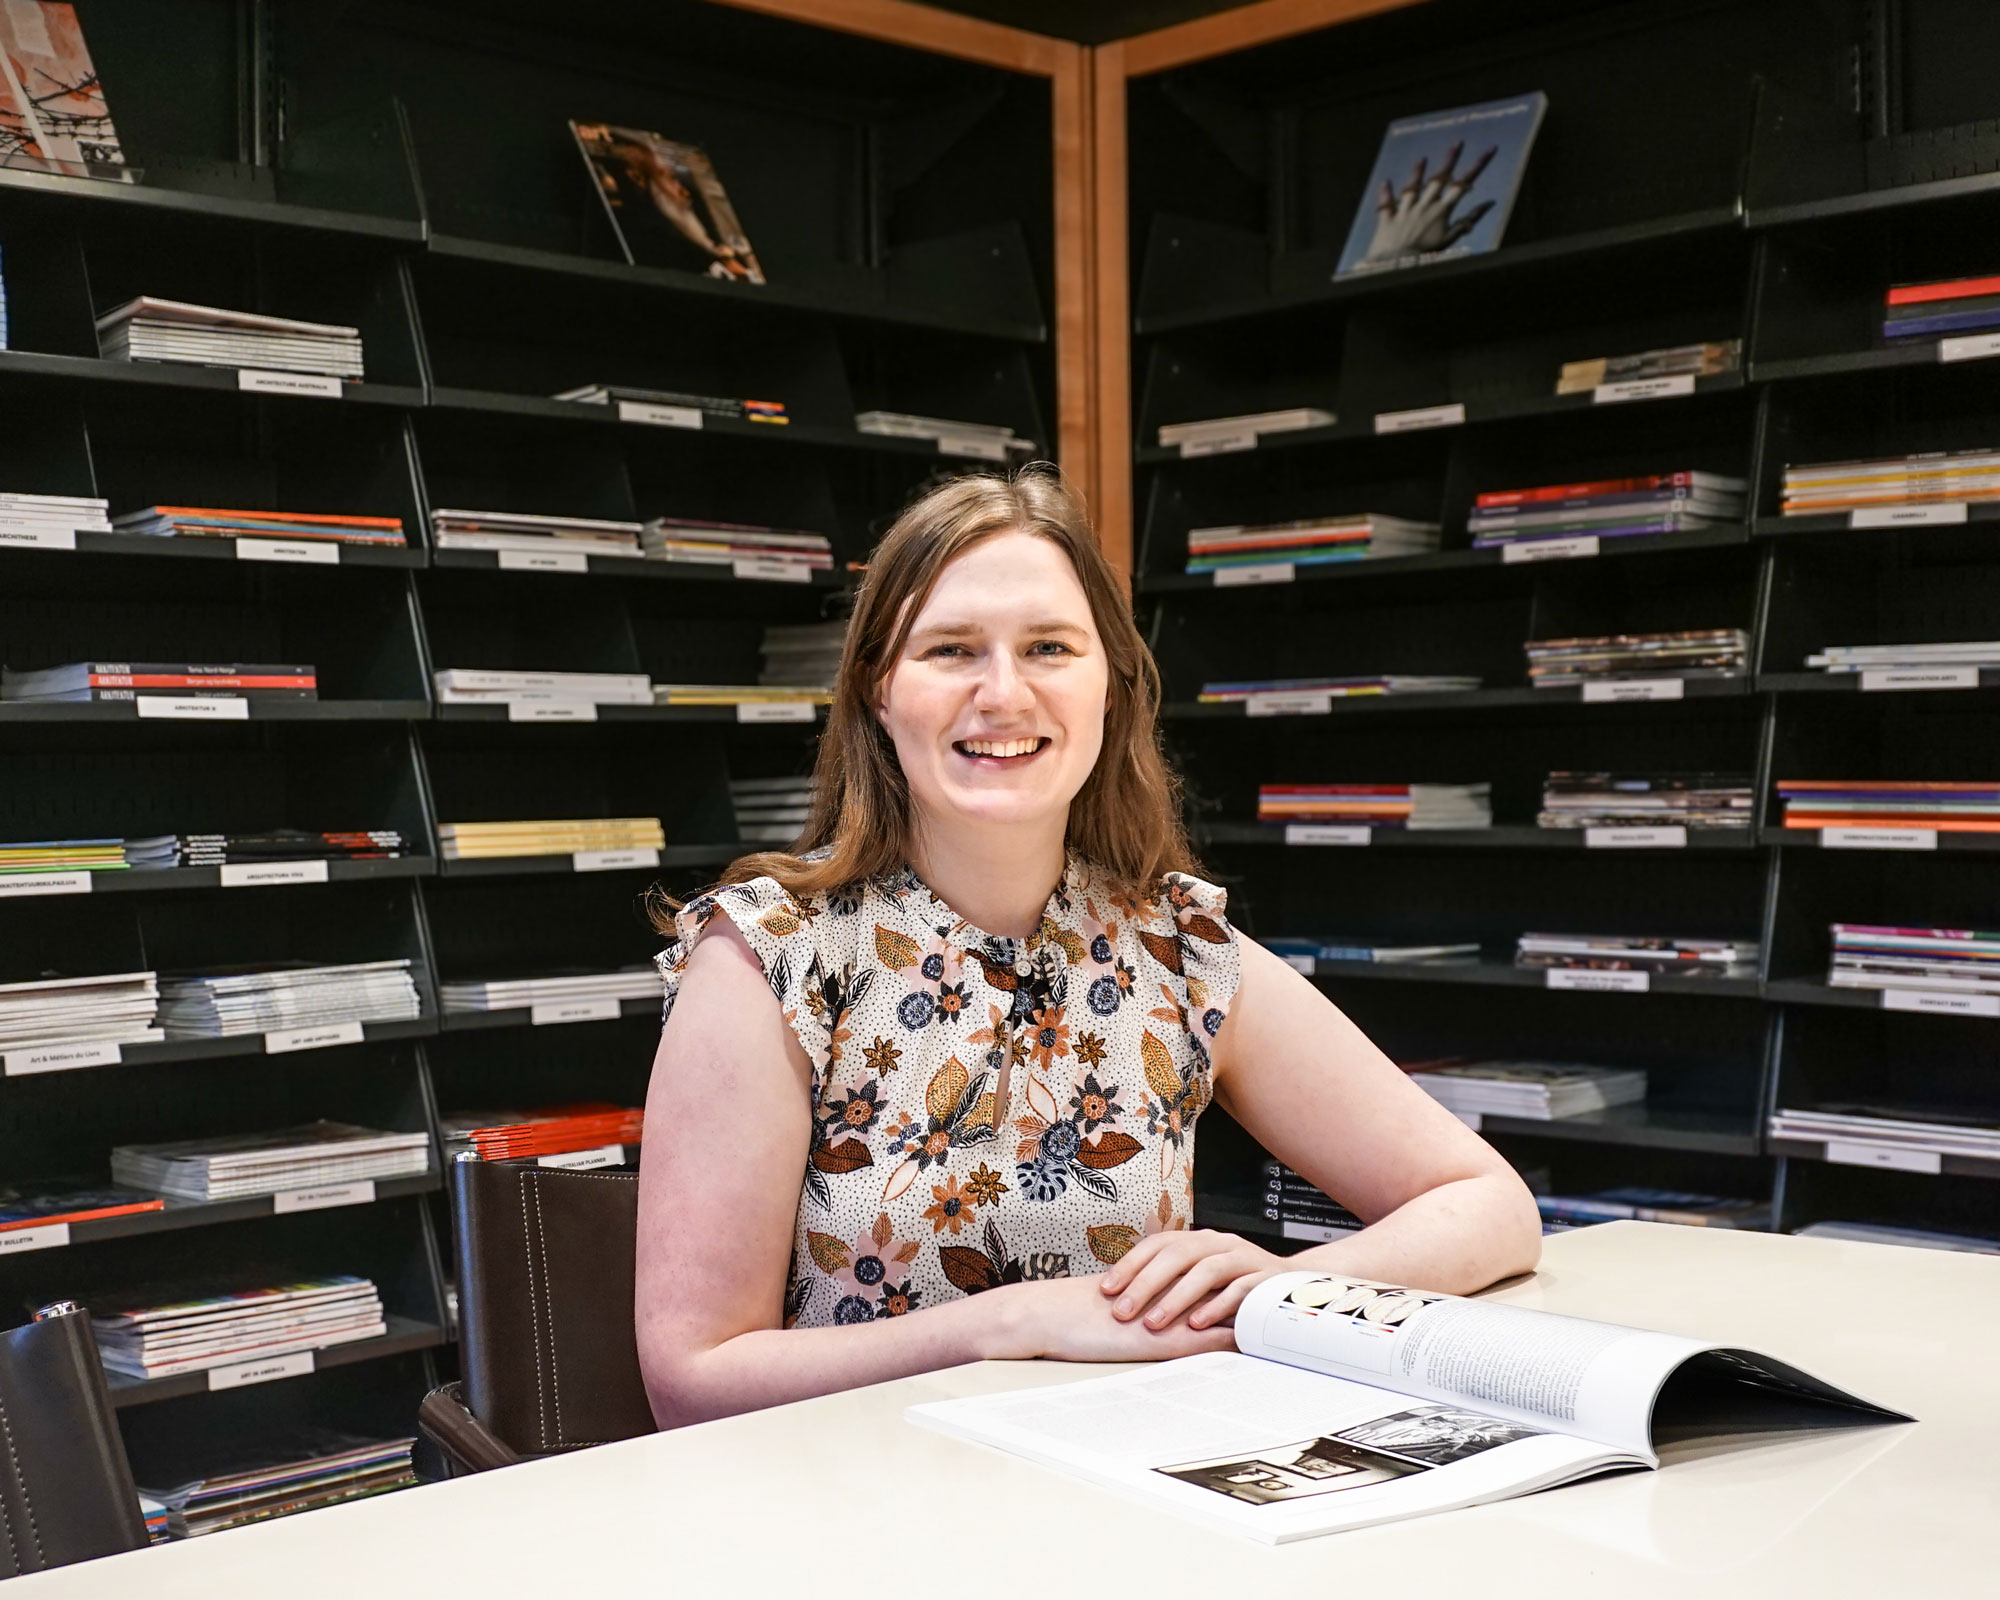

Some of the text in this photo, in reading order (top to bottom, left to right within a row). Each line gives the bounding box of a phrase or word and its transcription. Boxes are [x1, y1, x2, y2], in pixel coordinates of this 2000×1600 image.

[255, 379, 297, 388] ARCHITECTURE
[30, 1055, 41, 1063] Art
[49, 1050, 74, 1061] Métiers
[585, 1157, 607, 1165] PLANNER
[1269, 1166, 1280, 1177] C3
[1270, 1180, 1281, 1191] C3
[1267, 1193, 1279, 1205] C3
[1266, 1208, 1278, 1220] C3
[4, 1236, 33, 1246] BULLETIN
